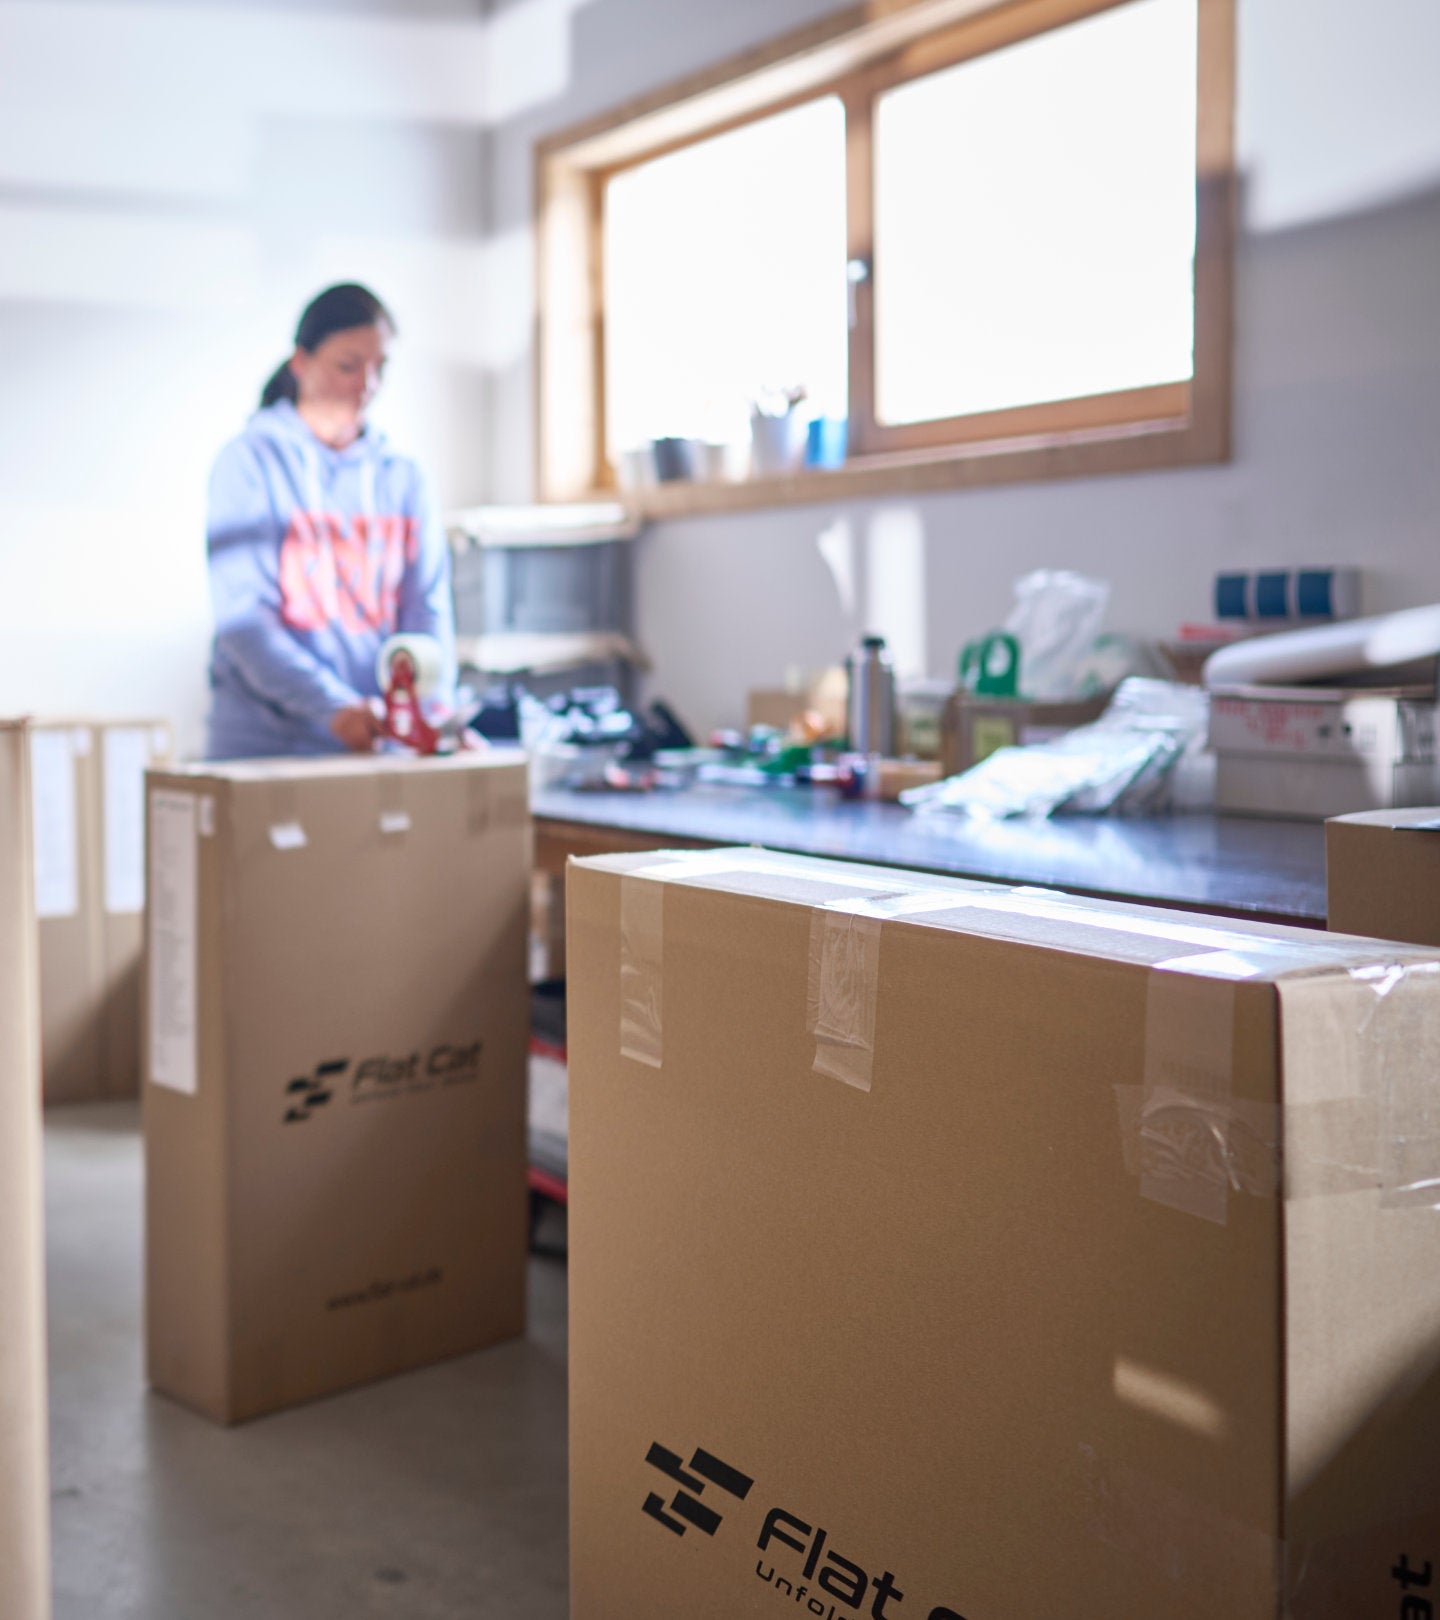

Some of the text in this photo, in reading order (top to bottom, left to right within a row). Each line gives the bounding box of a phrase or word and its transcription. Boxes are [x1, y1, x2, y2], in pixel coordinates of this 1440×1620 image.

[352, 1041, 482, 1089] Flat Cat
[756, 1507, 904, 1620] Flat
[756, 1560, 856, 1620] Unfol
